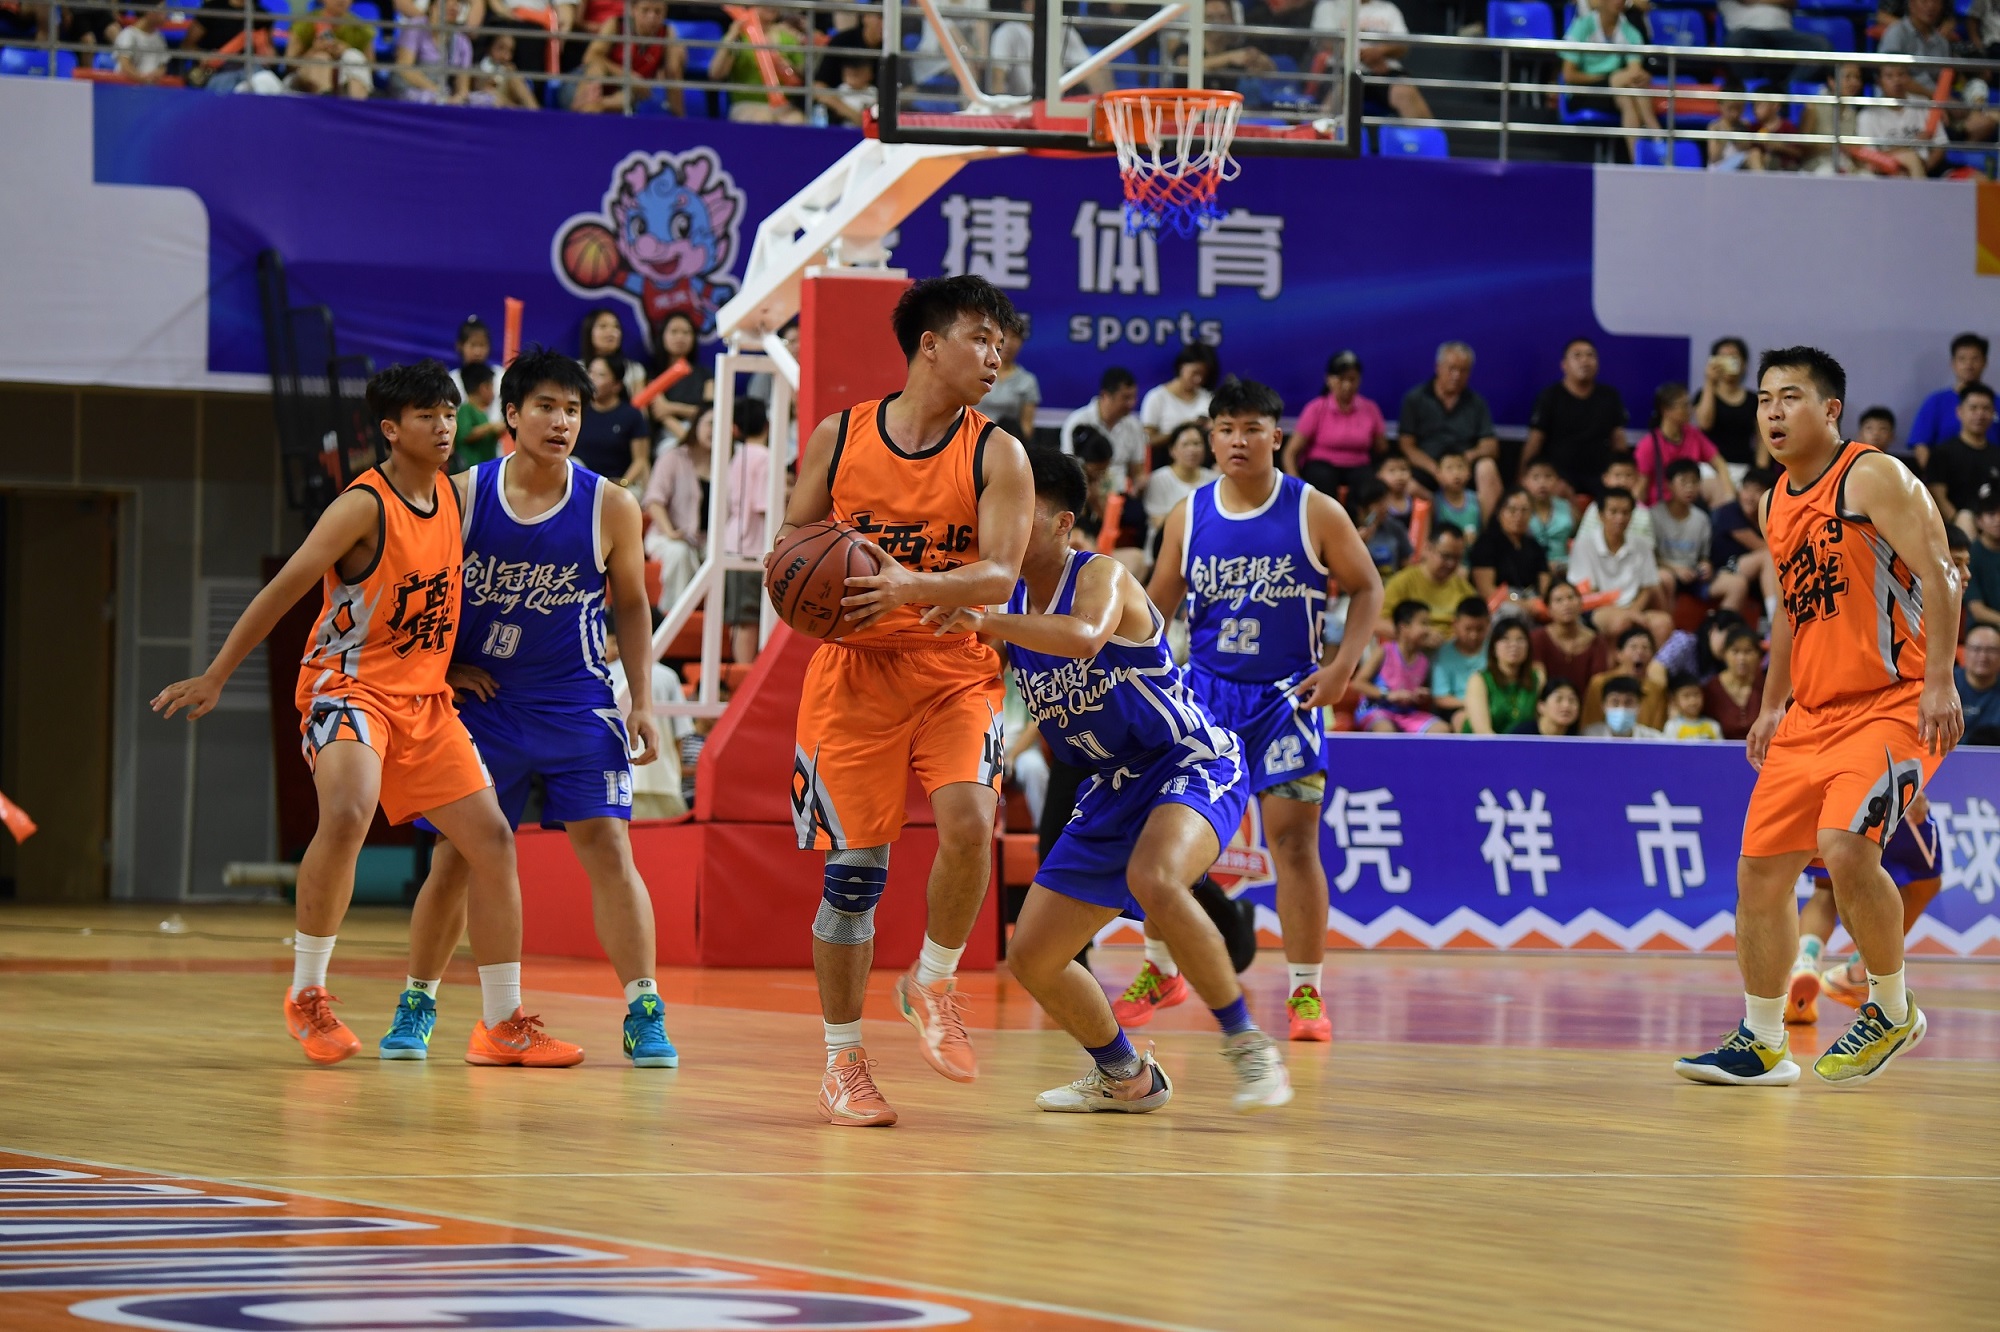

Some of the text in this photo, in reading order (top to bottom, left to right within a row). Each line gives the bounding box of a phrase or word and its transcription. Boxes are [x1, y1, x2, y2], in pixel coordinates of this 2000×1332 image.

[882, 193, 1284, 300] 捷体育
[1069, 312, 1222, 349] sports
[944, 524, 973, 552] 16
[1827, 519, 1843, 544] 9
[462, 550, 582, 592] 创冠报关
[1190, 553, 1297, 592] 创冠报关
[524, 586, 590, 615] Quan
[1250, 578, 1309, 607] Quan
[482, 621, 522, 659] 19
[1216, 617, 1261, 655] 22
[1068, 666, 1133, 715] Quan
[1065, 730, 1115, 760] 11
[1264, 734, 1305, 775] 22
[604, 771, 633, 807] 19
[1864, 797, 1888, 828] 9
